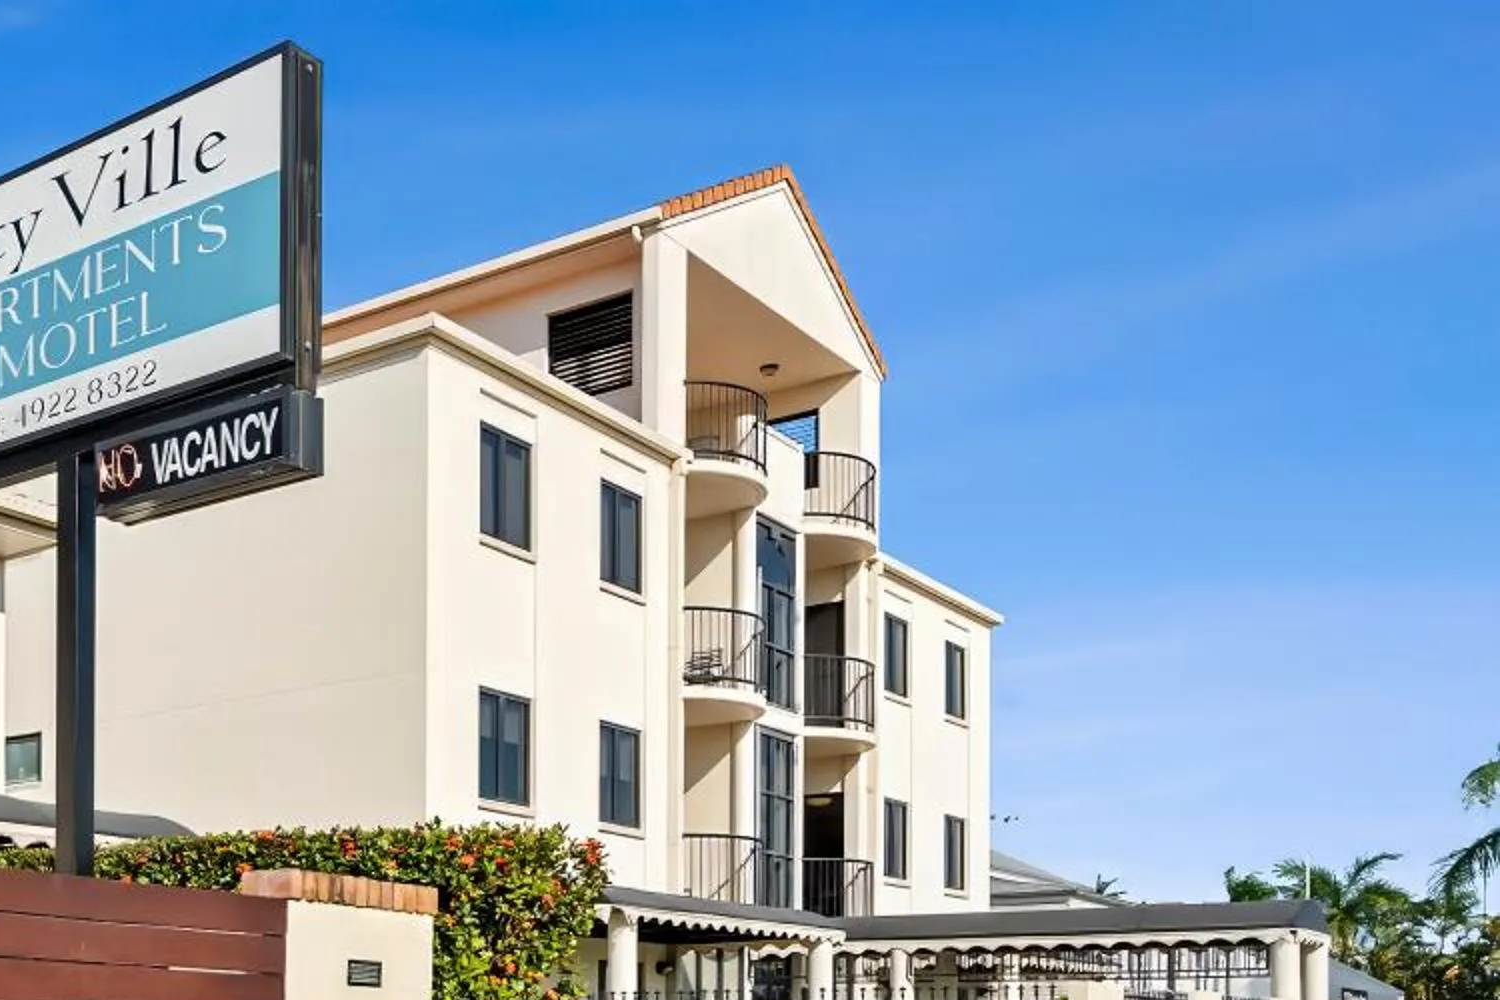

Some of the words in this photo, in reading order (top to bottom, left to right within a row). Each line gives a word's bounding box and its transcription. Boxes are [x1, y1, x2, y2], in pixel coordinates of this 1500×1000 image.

[51, 115, 228, 228] Ville
[0, 291, 168, 389] MOTEL
[87, 359, 158, 405] 8322
[98, 443, 143, 493] NO
[151, 406, 279, 485] VACANCY
